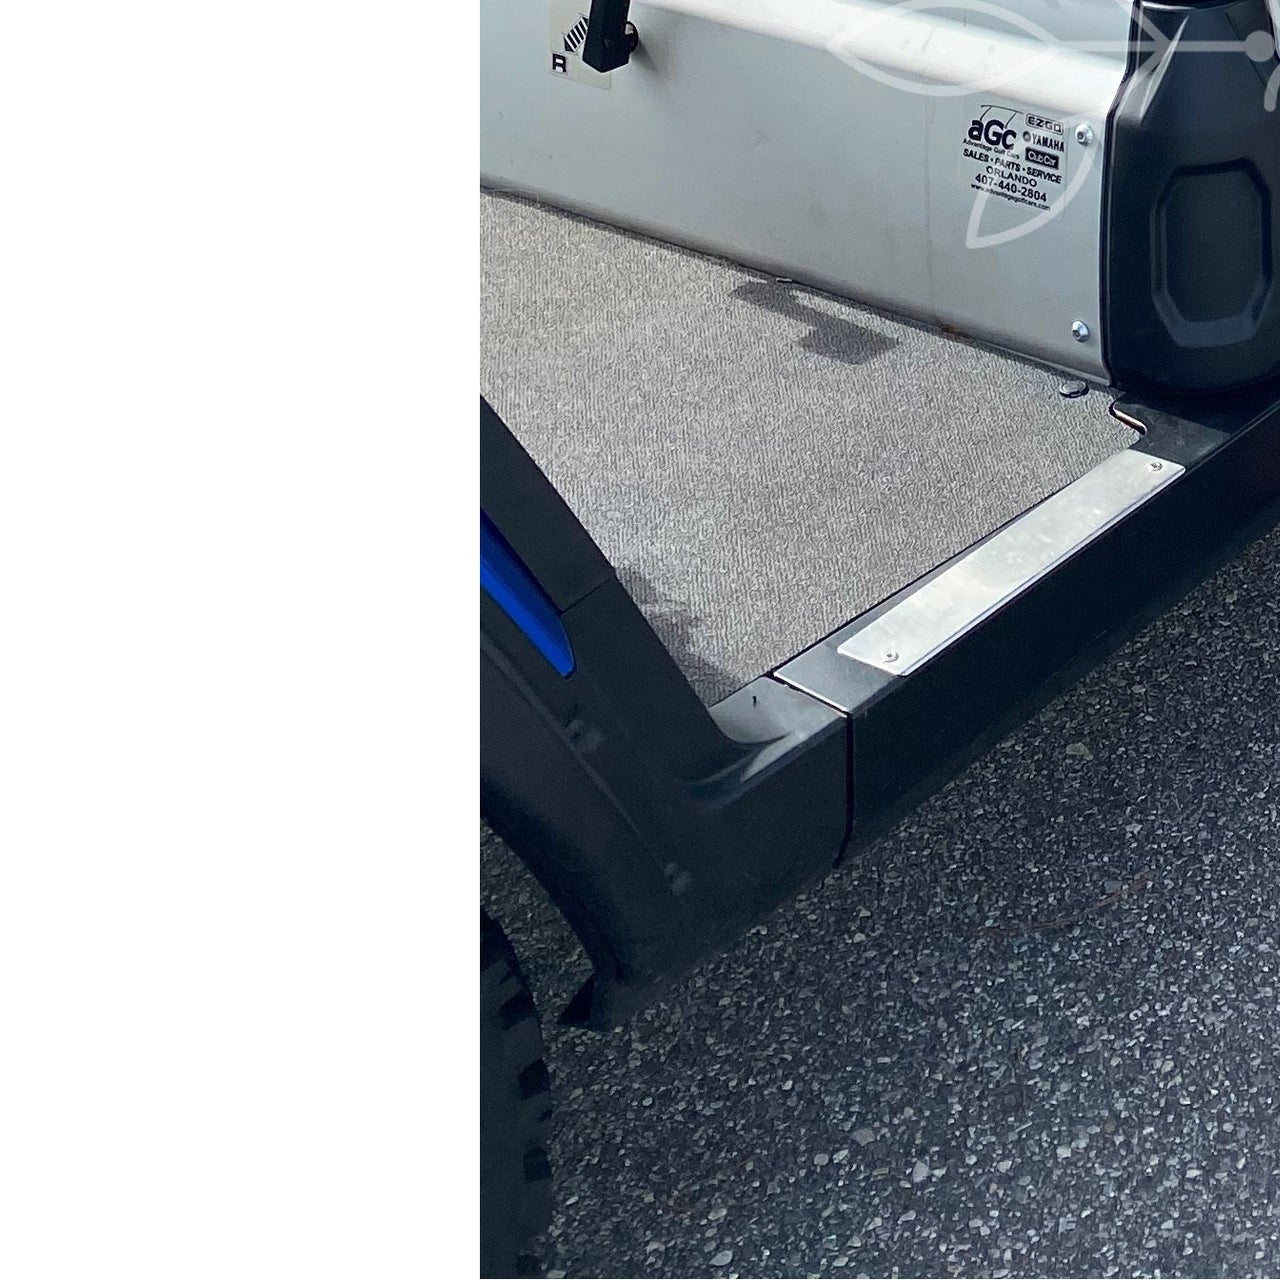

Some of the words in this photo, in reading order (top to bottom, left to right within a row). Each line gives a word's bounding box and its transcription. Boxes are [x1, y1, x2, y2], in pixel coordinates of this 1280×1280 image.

[552, 53, 567, 73] R
[1032, 133, 1065, 152] YAMAHA
[963, 148, 989, 163] SALES
[994, 157, 1021, 172] PARTS
[1026, 166, 1062, 184] SERVICE
[986, 166, 1037, 187] ORLANDO
[975, 173, 1047, 203] 407-440-2804
